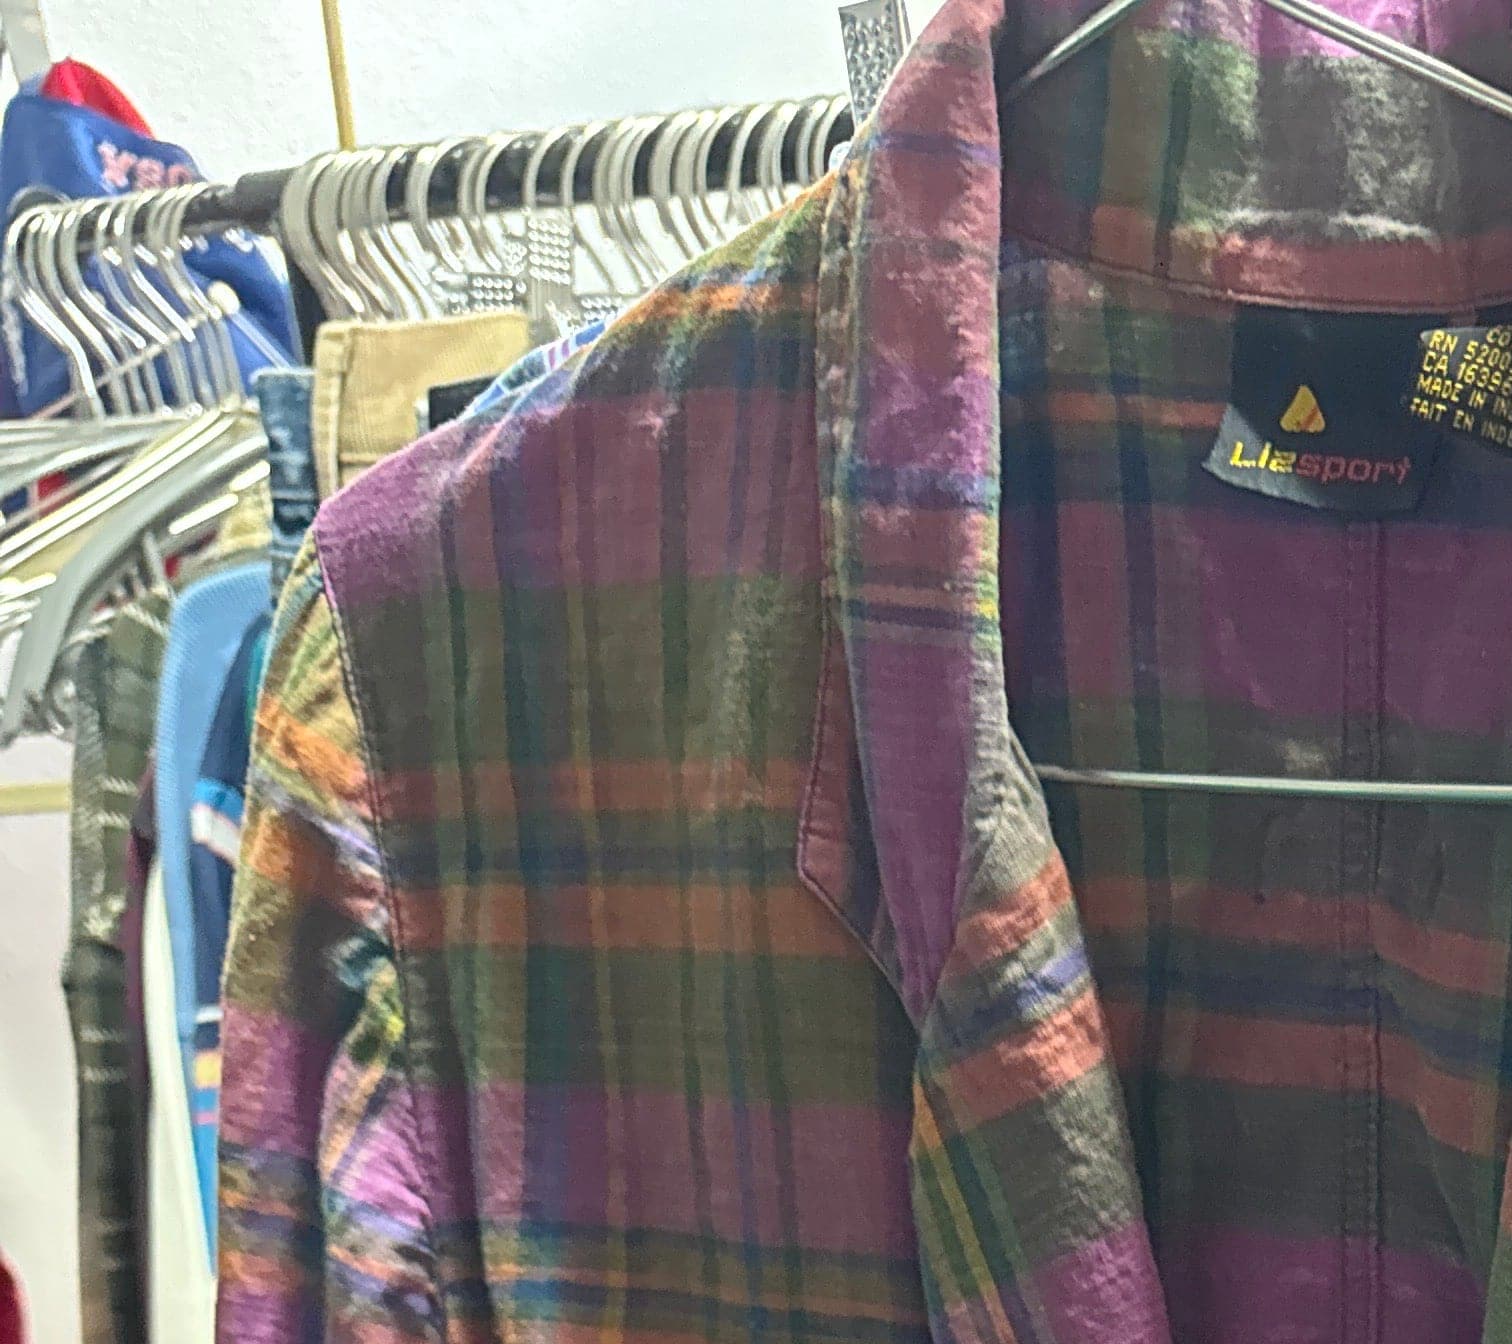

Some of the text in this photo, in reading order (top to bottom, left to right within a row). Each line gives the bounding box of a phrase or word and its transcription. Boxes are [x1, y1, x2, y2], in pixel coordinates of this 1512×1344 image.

[1429, 330, 1458, 355] RN
[1423, 350, 1448, 376] CA
[1417, 373, 1463, 402] MADE
[1468, 390, 1486, 409] IN
[1410, 397, 1447, 421] FAIT
[1453, 410, 1474, 431] EN
